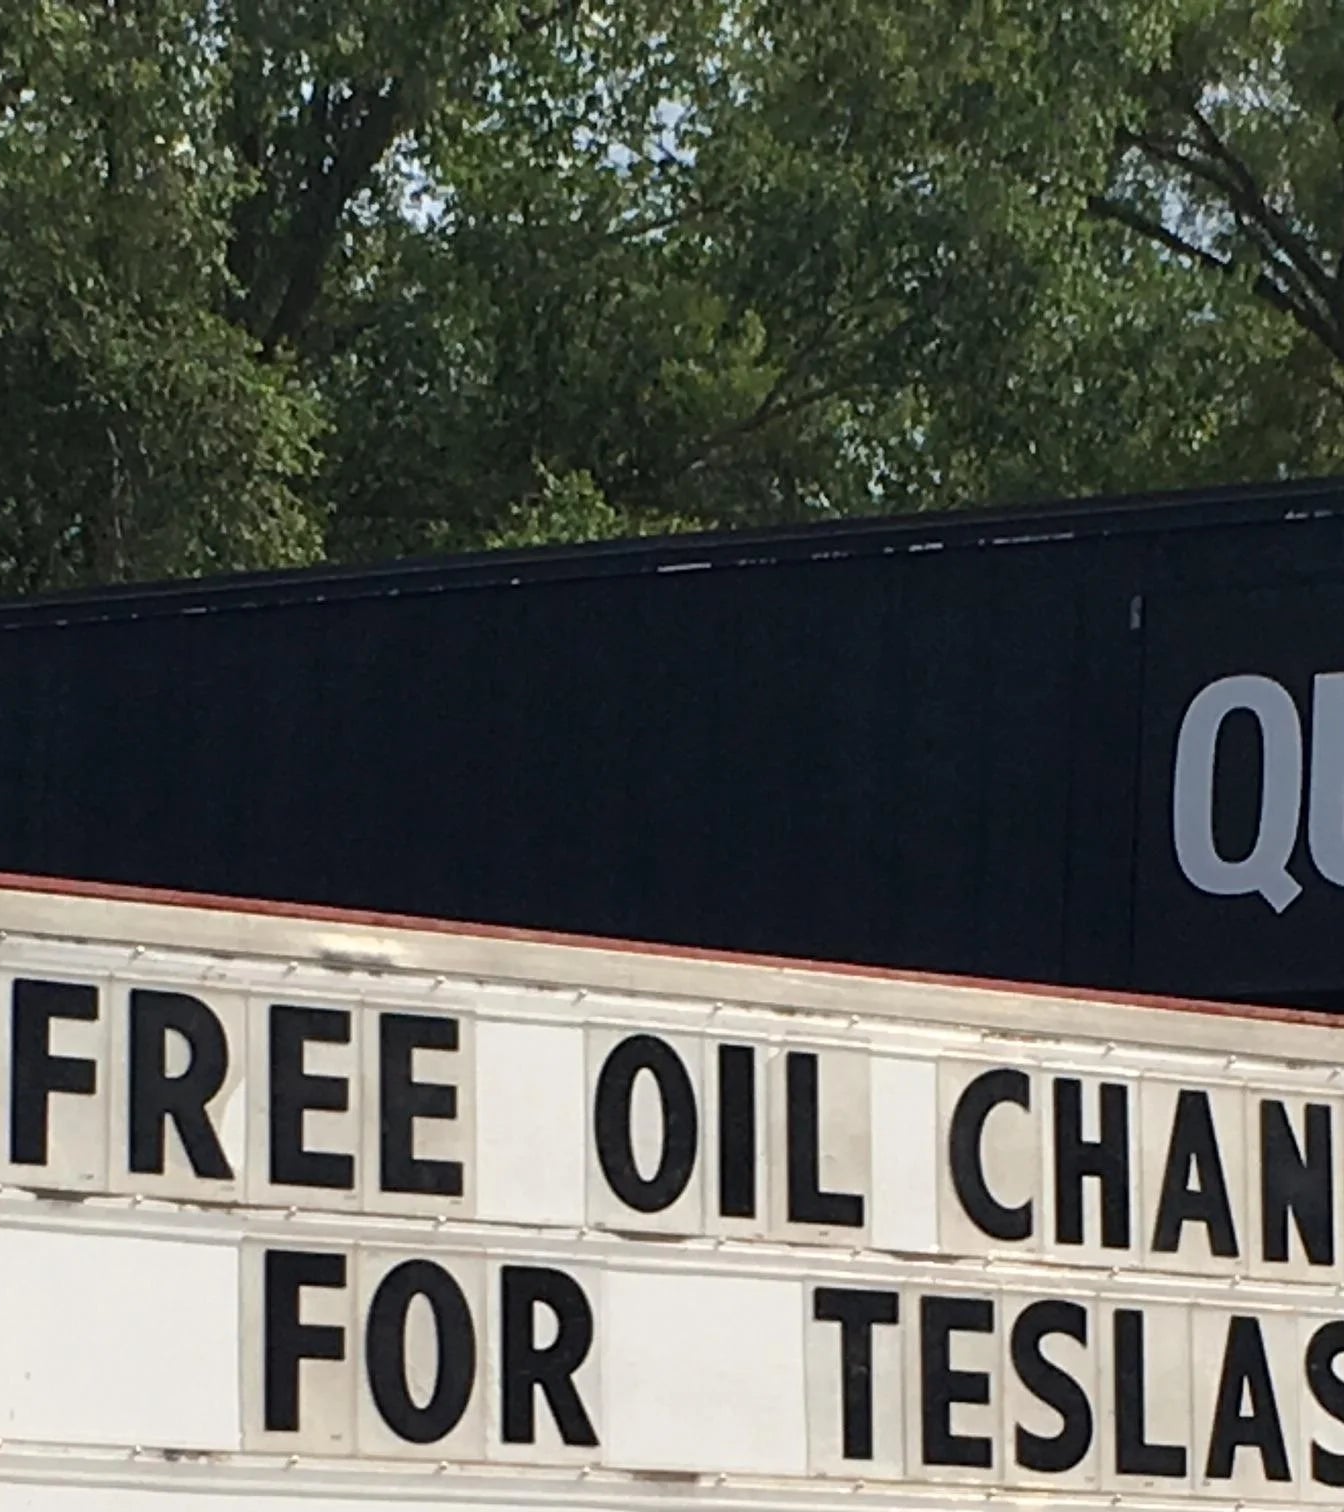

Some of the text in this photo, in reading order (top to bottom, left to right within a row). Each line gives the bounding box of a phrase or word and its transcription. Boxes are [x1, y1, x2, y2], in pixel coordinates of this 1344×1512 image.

[10, 977, 464, 1197] FREE
[594, 1033, 864, 1228] OIL
[264, 1248, 599, 1447] FOR
